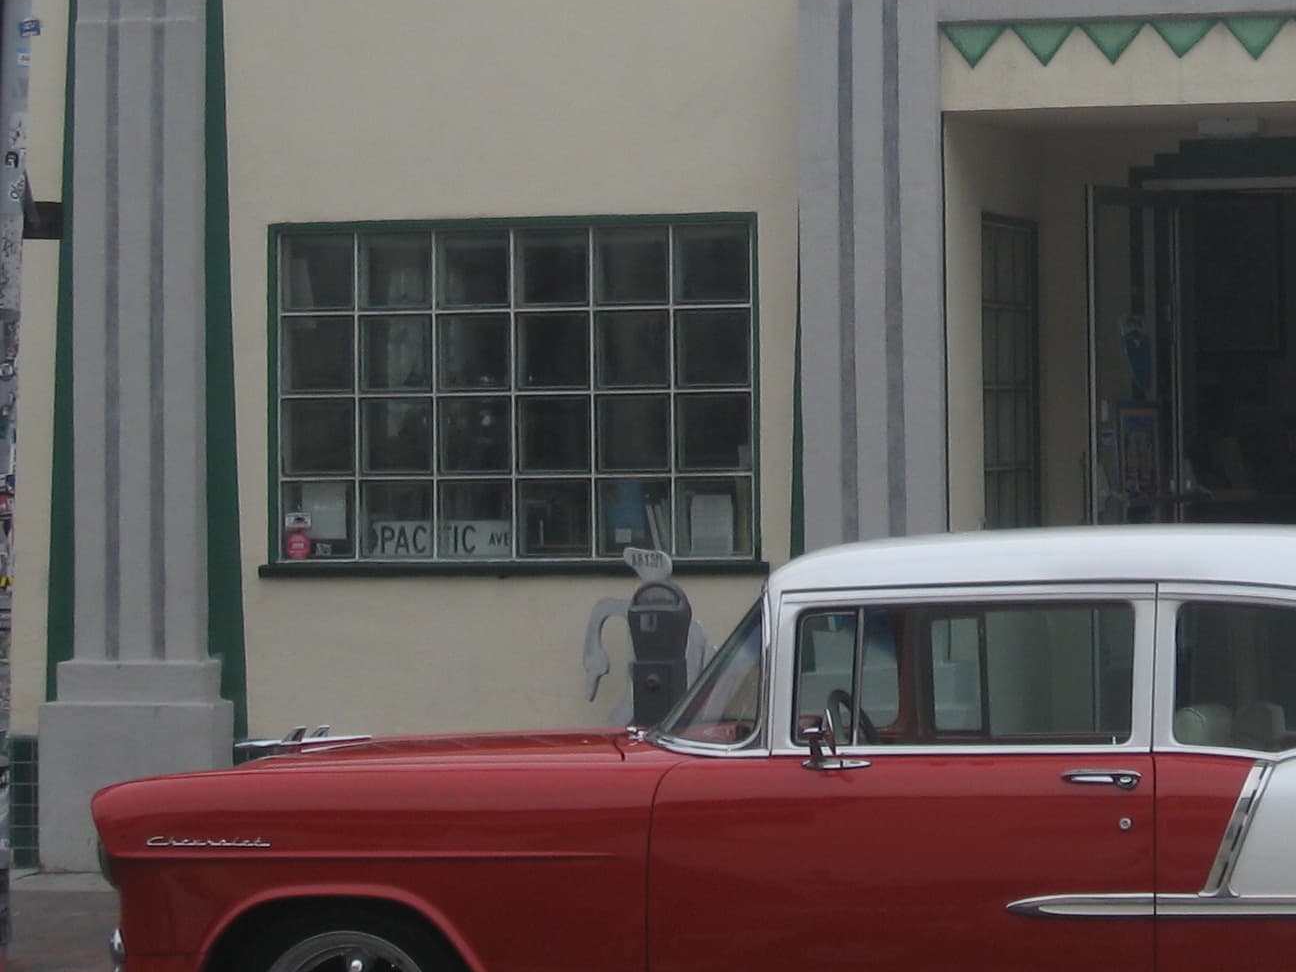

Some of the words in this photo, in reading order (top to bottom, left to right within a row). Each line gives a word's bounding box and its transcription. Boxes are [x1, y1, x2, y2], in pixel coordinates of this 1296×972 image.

[380, 524, 476, 554] PACIC
[488, 531, 509, 547] AVE
[146, 835, 271, 847] Chevrolet
